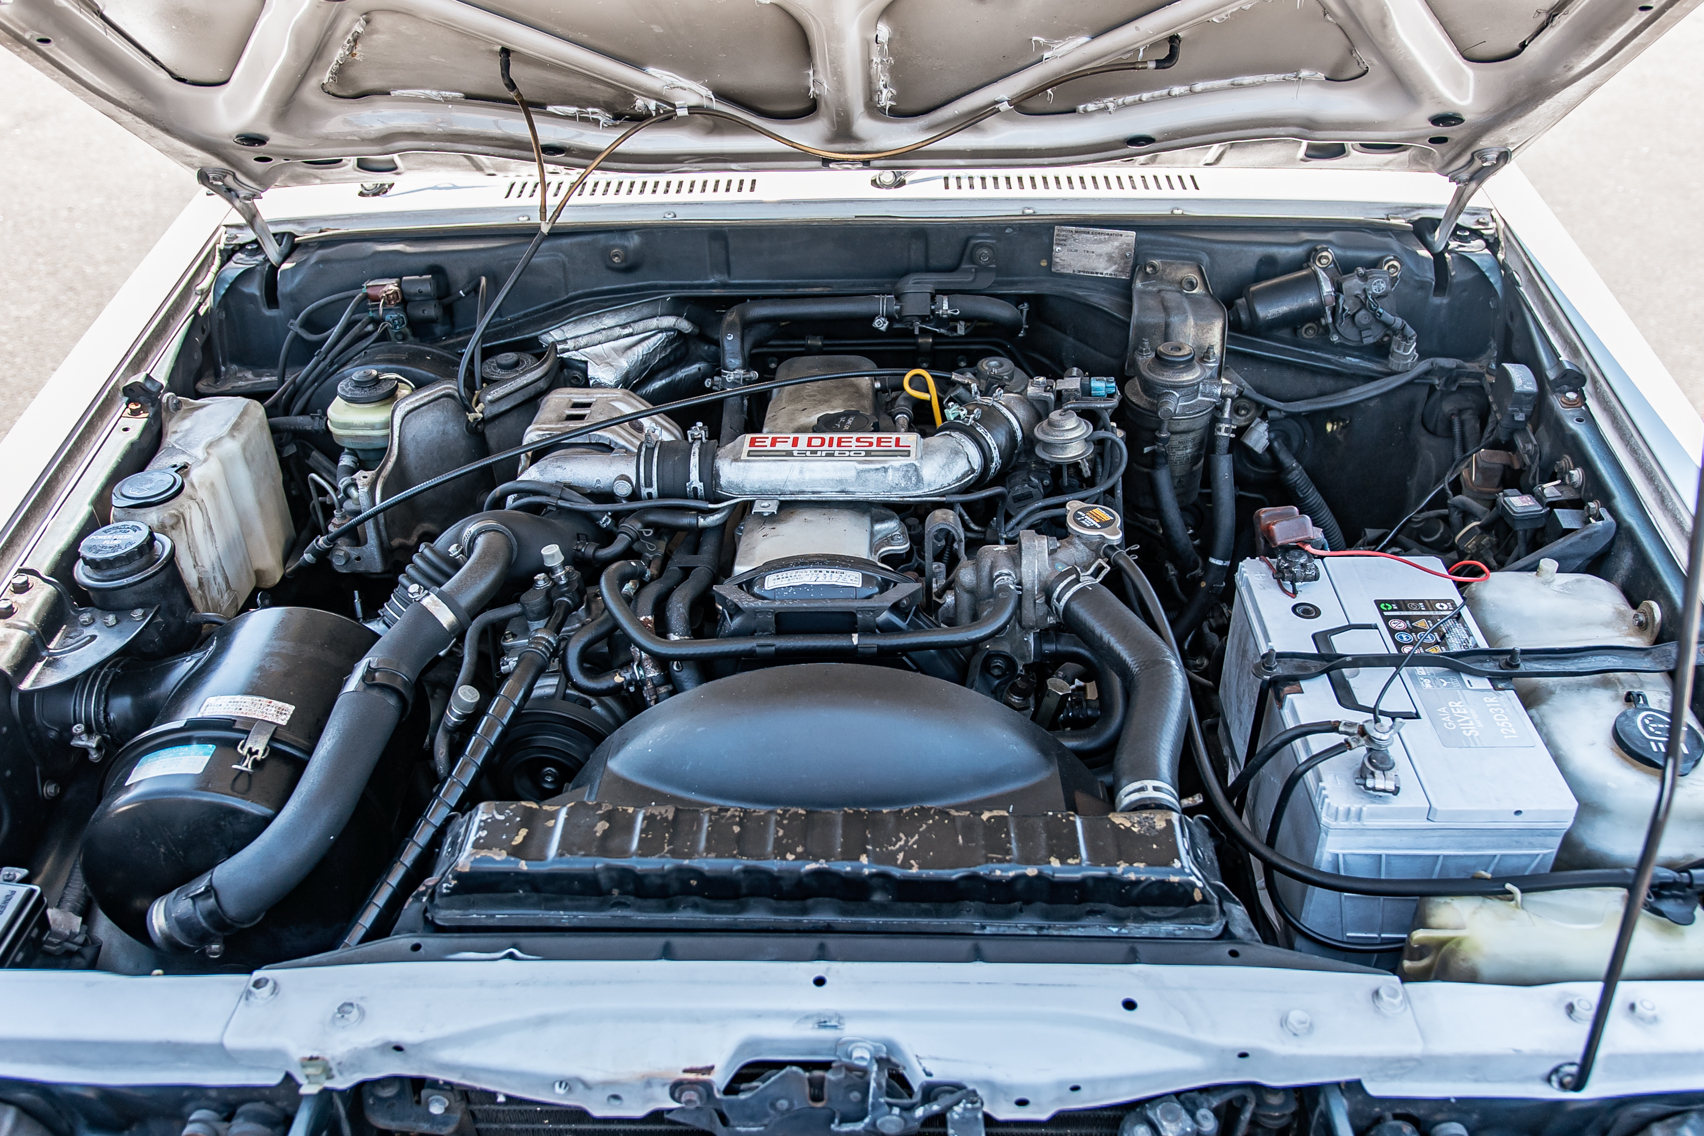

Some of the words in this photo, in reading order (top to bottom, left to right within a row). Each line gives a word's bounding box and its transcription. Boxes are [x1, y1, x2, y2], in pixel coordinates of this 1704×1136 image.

[748, 436, 800, 448] EFI
[806, 436, 911, 448] DIESEL
[1437, 706, 1456, 730] GAIA
[1448, 700, 1479, 738] SILVER
[1484, 696, 1519, 739] 125D31R
